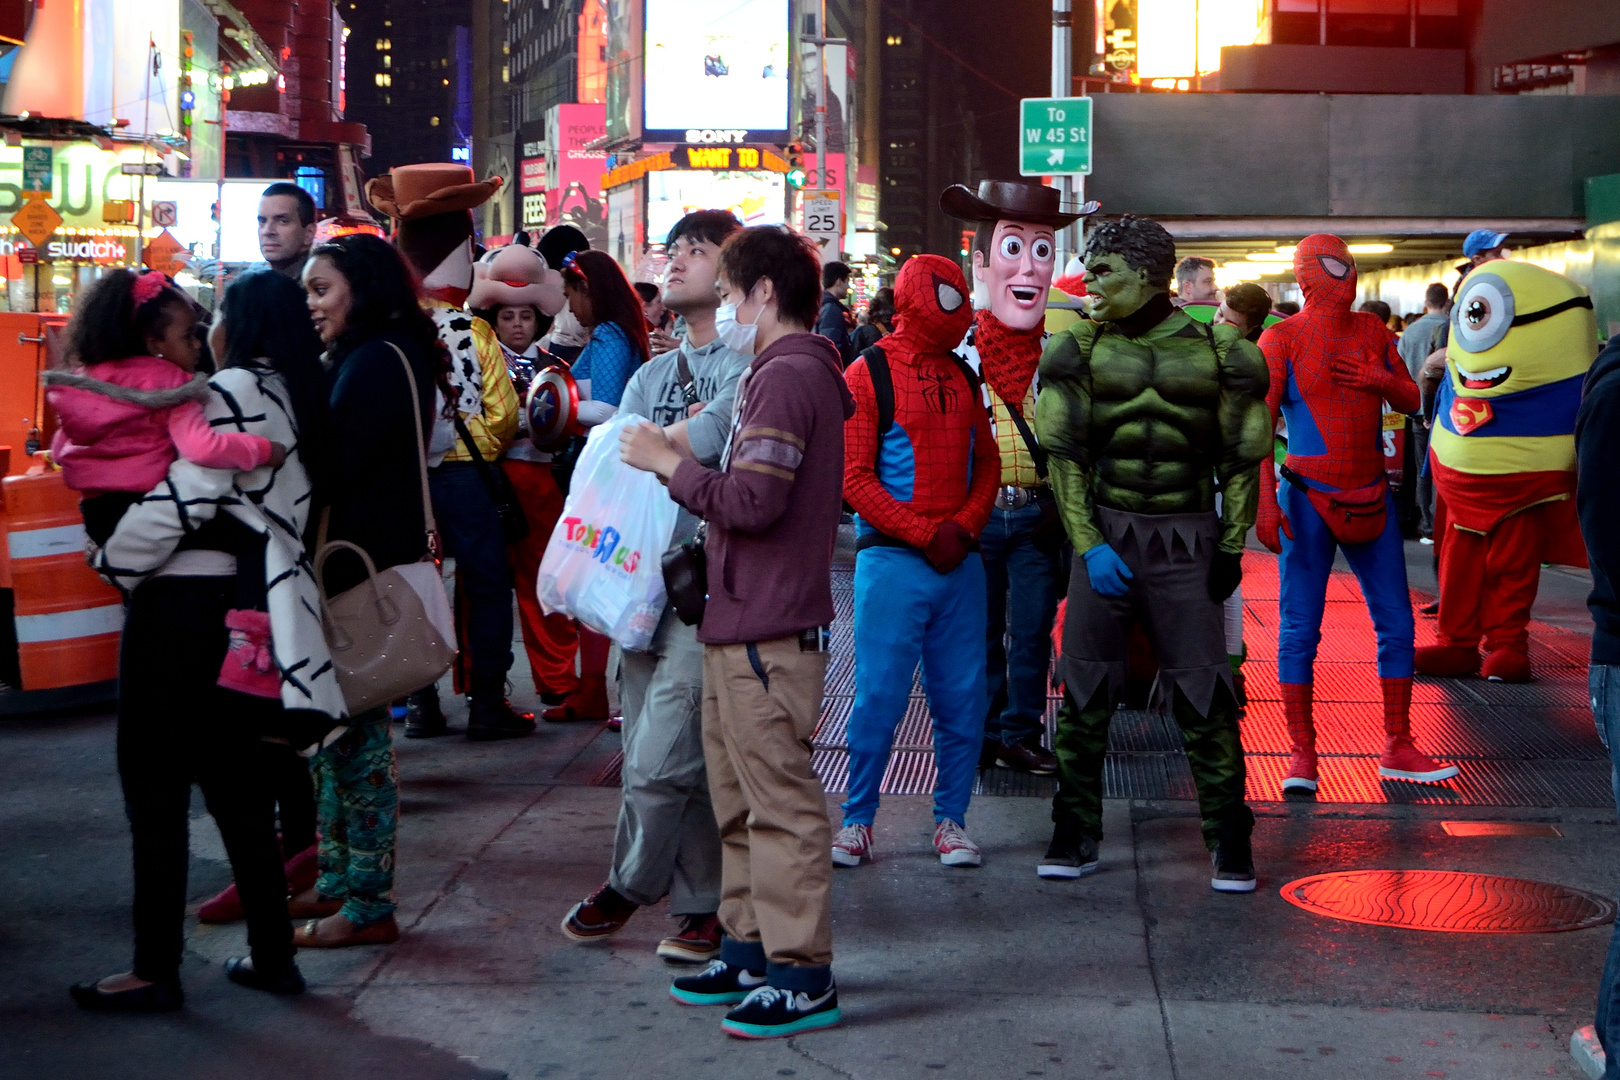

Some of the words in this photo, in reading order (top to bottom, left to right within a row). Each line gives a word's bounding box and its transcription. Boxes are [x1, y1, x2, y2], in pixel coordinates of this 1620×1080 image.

[1047, 107, 1066, 122] To
[685, 129, 748, 143] SONY
[1026, 128, 1041, 143] W
[1046, 128, 1065, 143] 45
[1070, 127, 1086, 143] St
[687, 148, 732, 168] WANT
[736, 148, 759, 168] TO
[808, 215, 835, 231] 25
